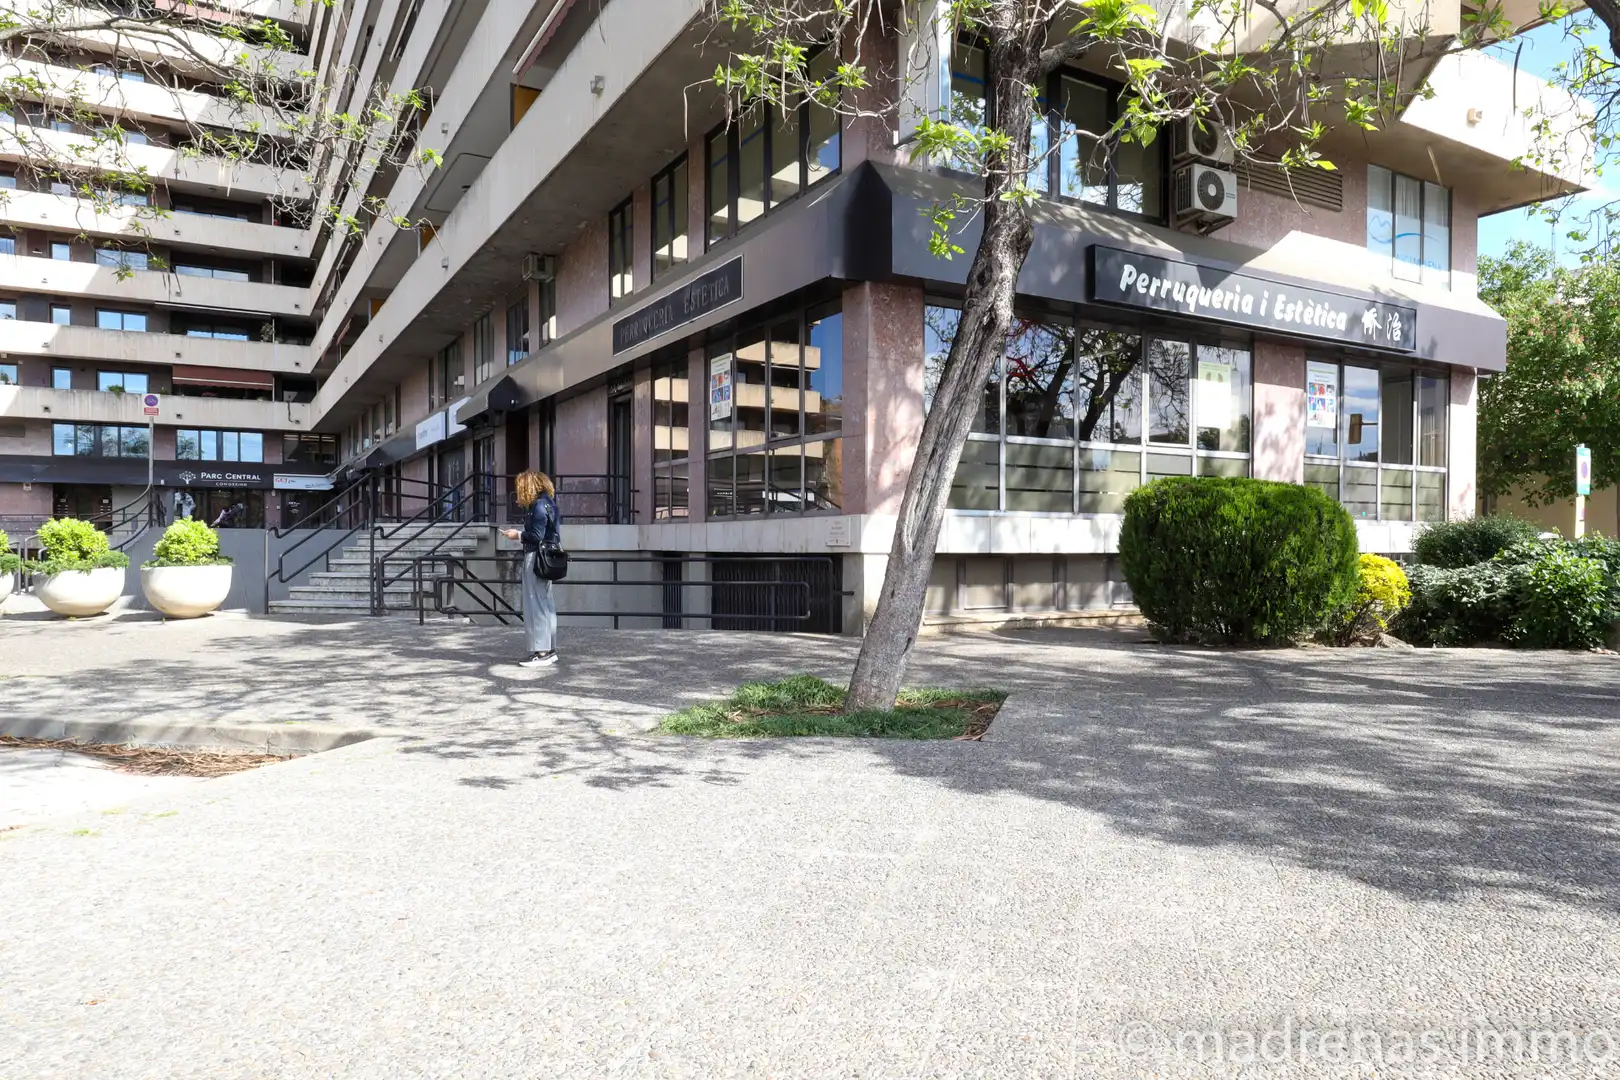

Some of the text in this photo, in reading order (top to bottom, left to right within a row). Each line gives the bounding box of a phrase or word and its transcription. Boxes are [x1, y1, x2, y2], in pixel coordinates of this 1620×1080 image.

[1119, 264, 1348, 332] Perruqueria i Estètica
